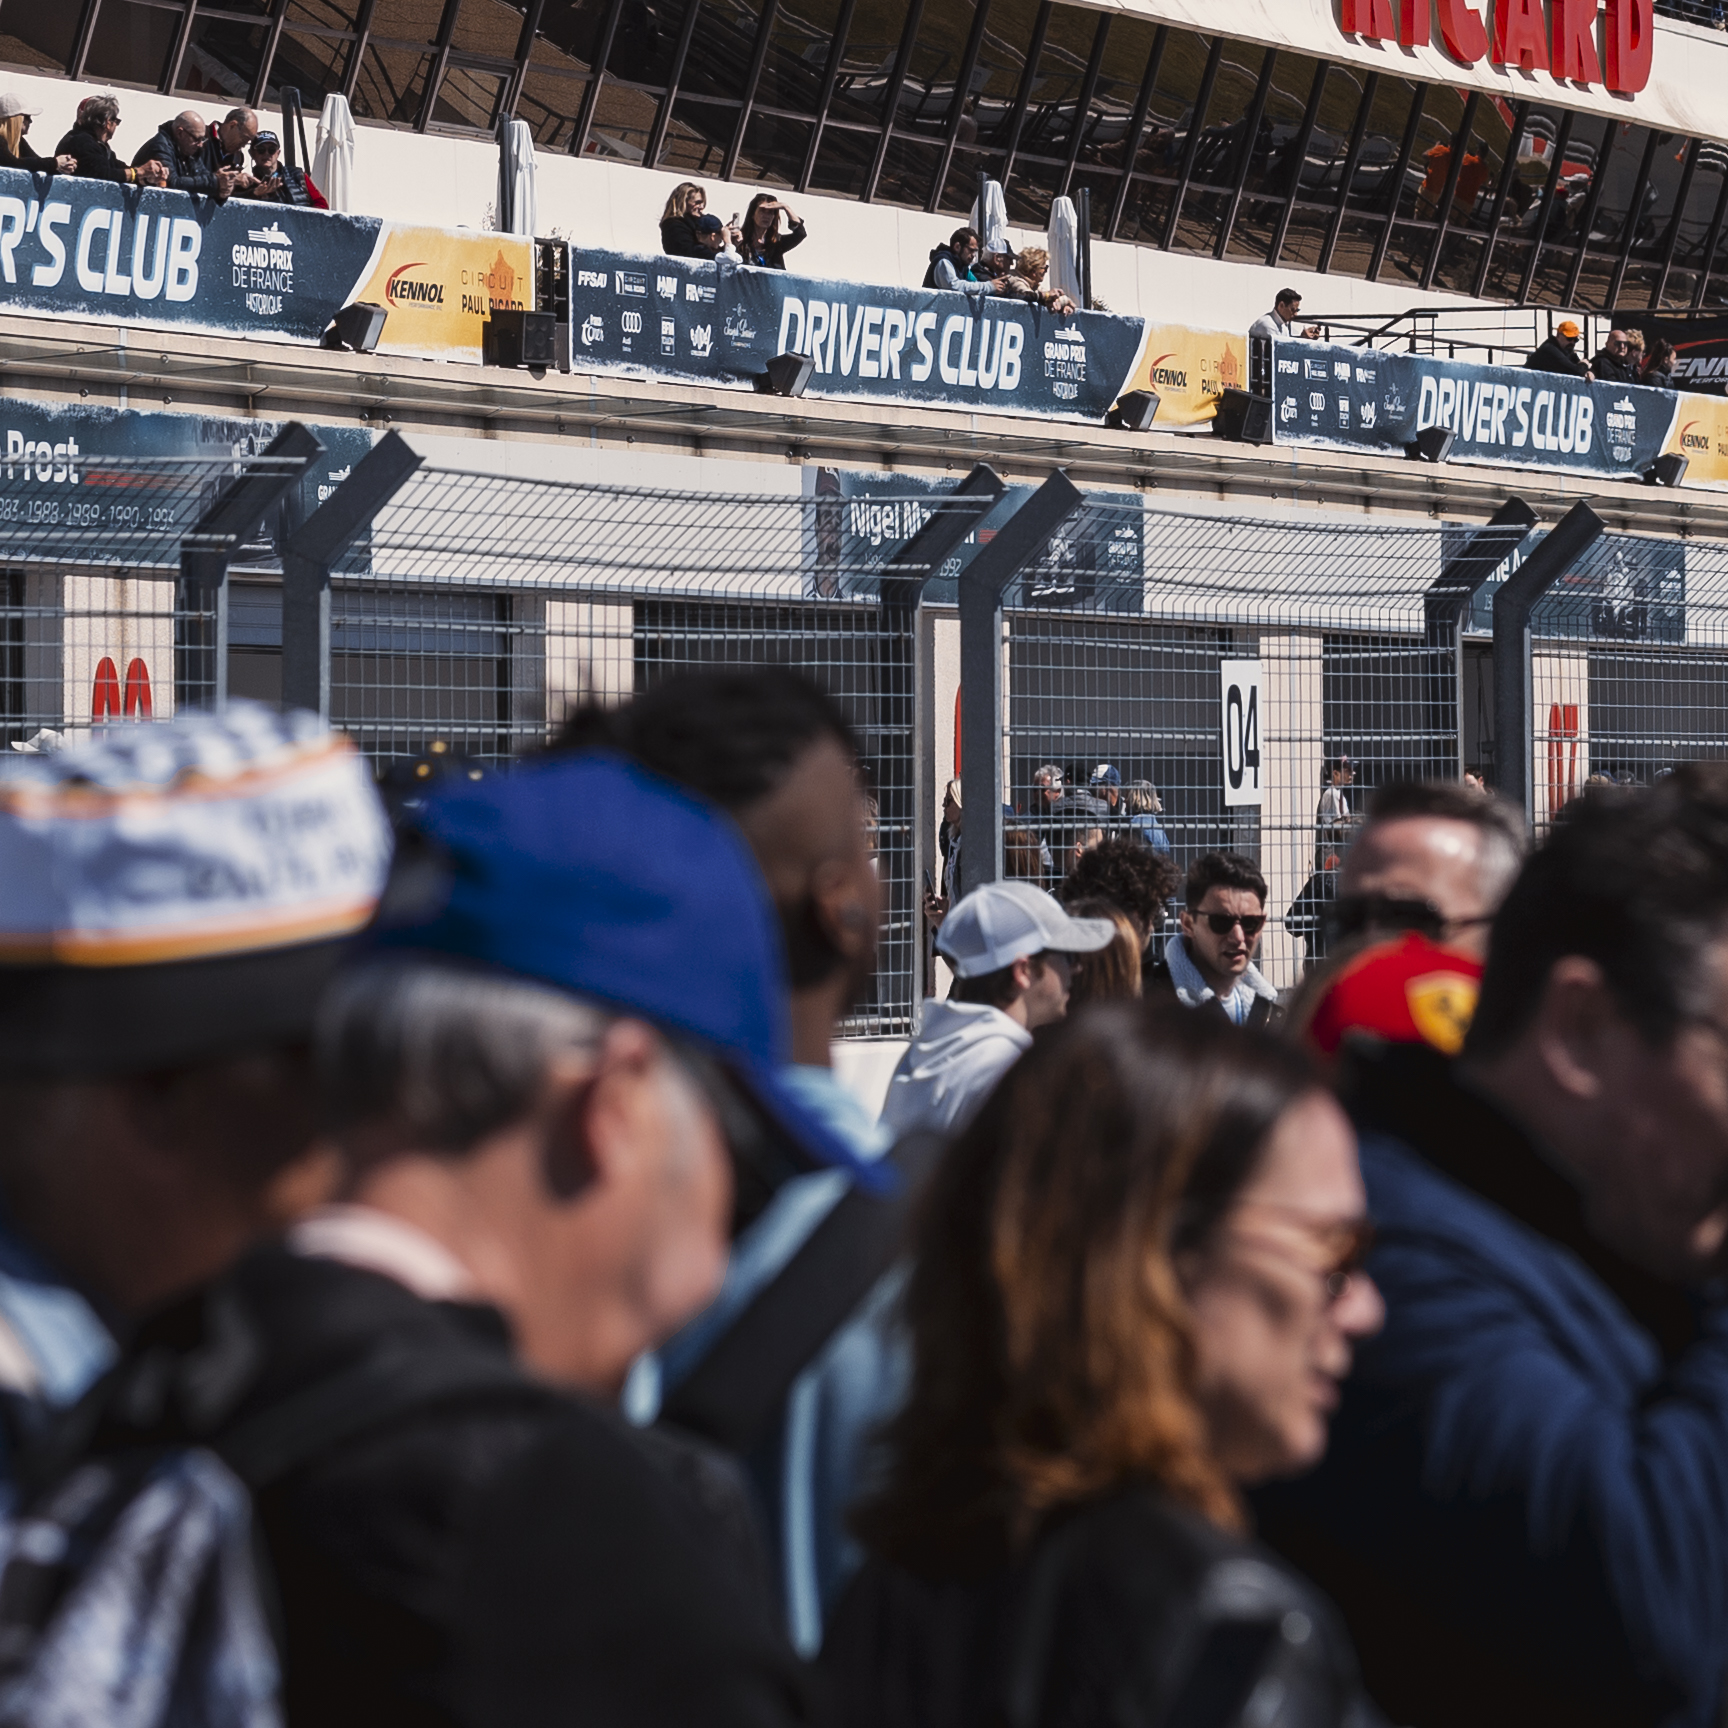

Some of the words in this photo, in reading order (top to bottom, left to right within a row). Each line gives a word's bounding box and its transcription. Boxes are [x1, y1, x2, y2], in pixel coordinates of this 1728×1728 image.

[76, 208, 202, 302] CLUB
[232, 244, 269, 270] GRAND
[270, 249, 293, 271] PRIX
[232, 266, 248, 287] DE
[250, 269, 294, 294] FRANCE
[389, 278, 444, 303] KENNOL
[461, 269, 523, 292] CIRCUIT
[246, 292, 282, 315] HISTORIQUE
[461, 294, 485, 316] PAUL
[778, 296, 937, 382] DRIVER'S
[939, 315, 1024, 390] CLUB
[1044, 341, 1069, 361] GRAND
[1070, 345, 1086, 363] PRIX
[1044, 359, 1055, 377] DE
[1057, 362, 1086, 382] FRANCE
[1152, 367, 1187, 387] KENNOL
[1417, 376, 1532, 447] DRIVER'S
[1532, 390, 1594, 454] CLUB
[1682, 434, 1709, 450] KENNOL
[7, 430, 79, 484] Prost
[850, 492, 900, 546] Nigel
[1226, 683, 1260, 789] 04
